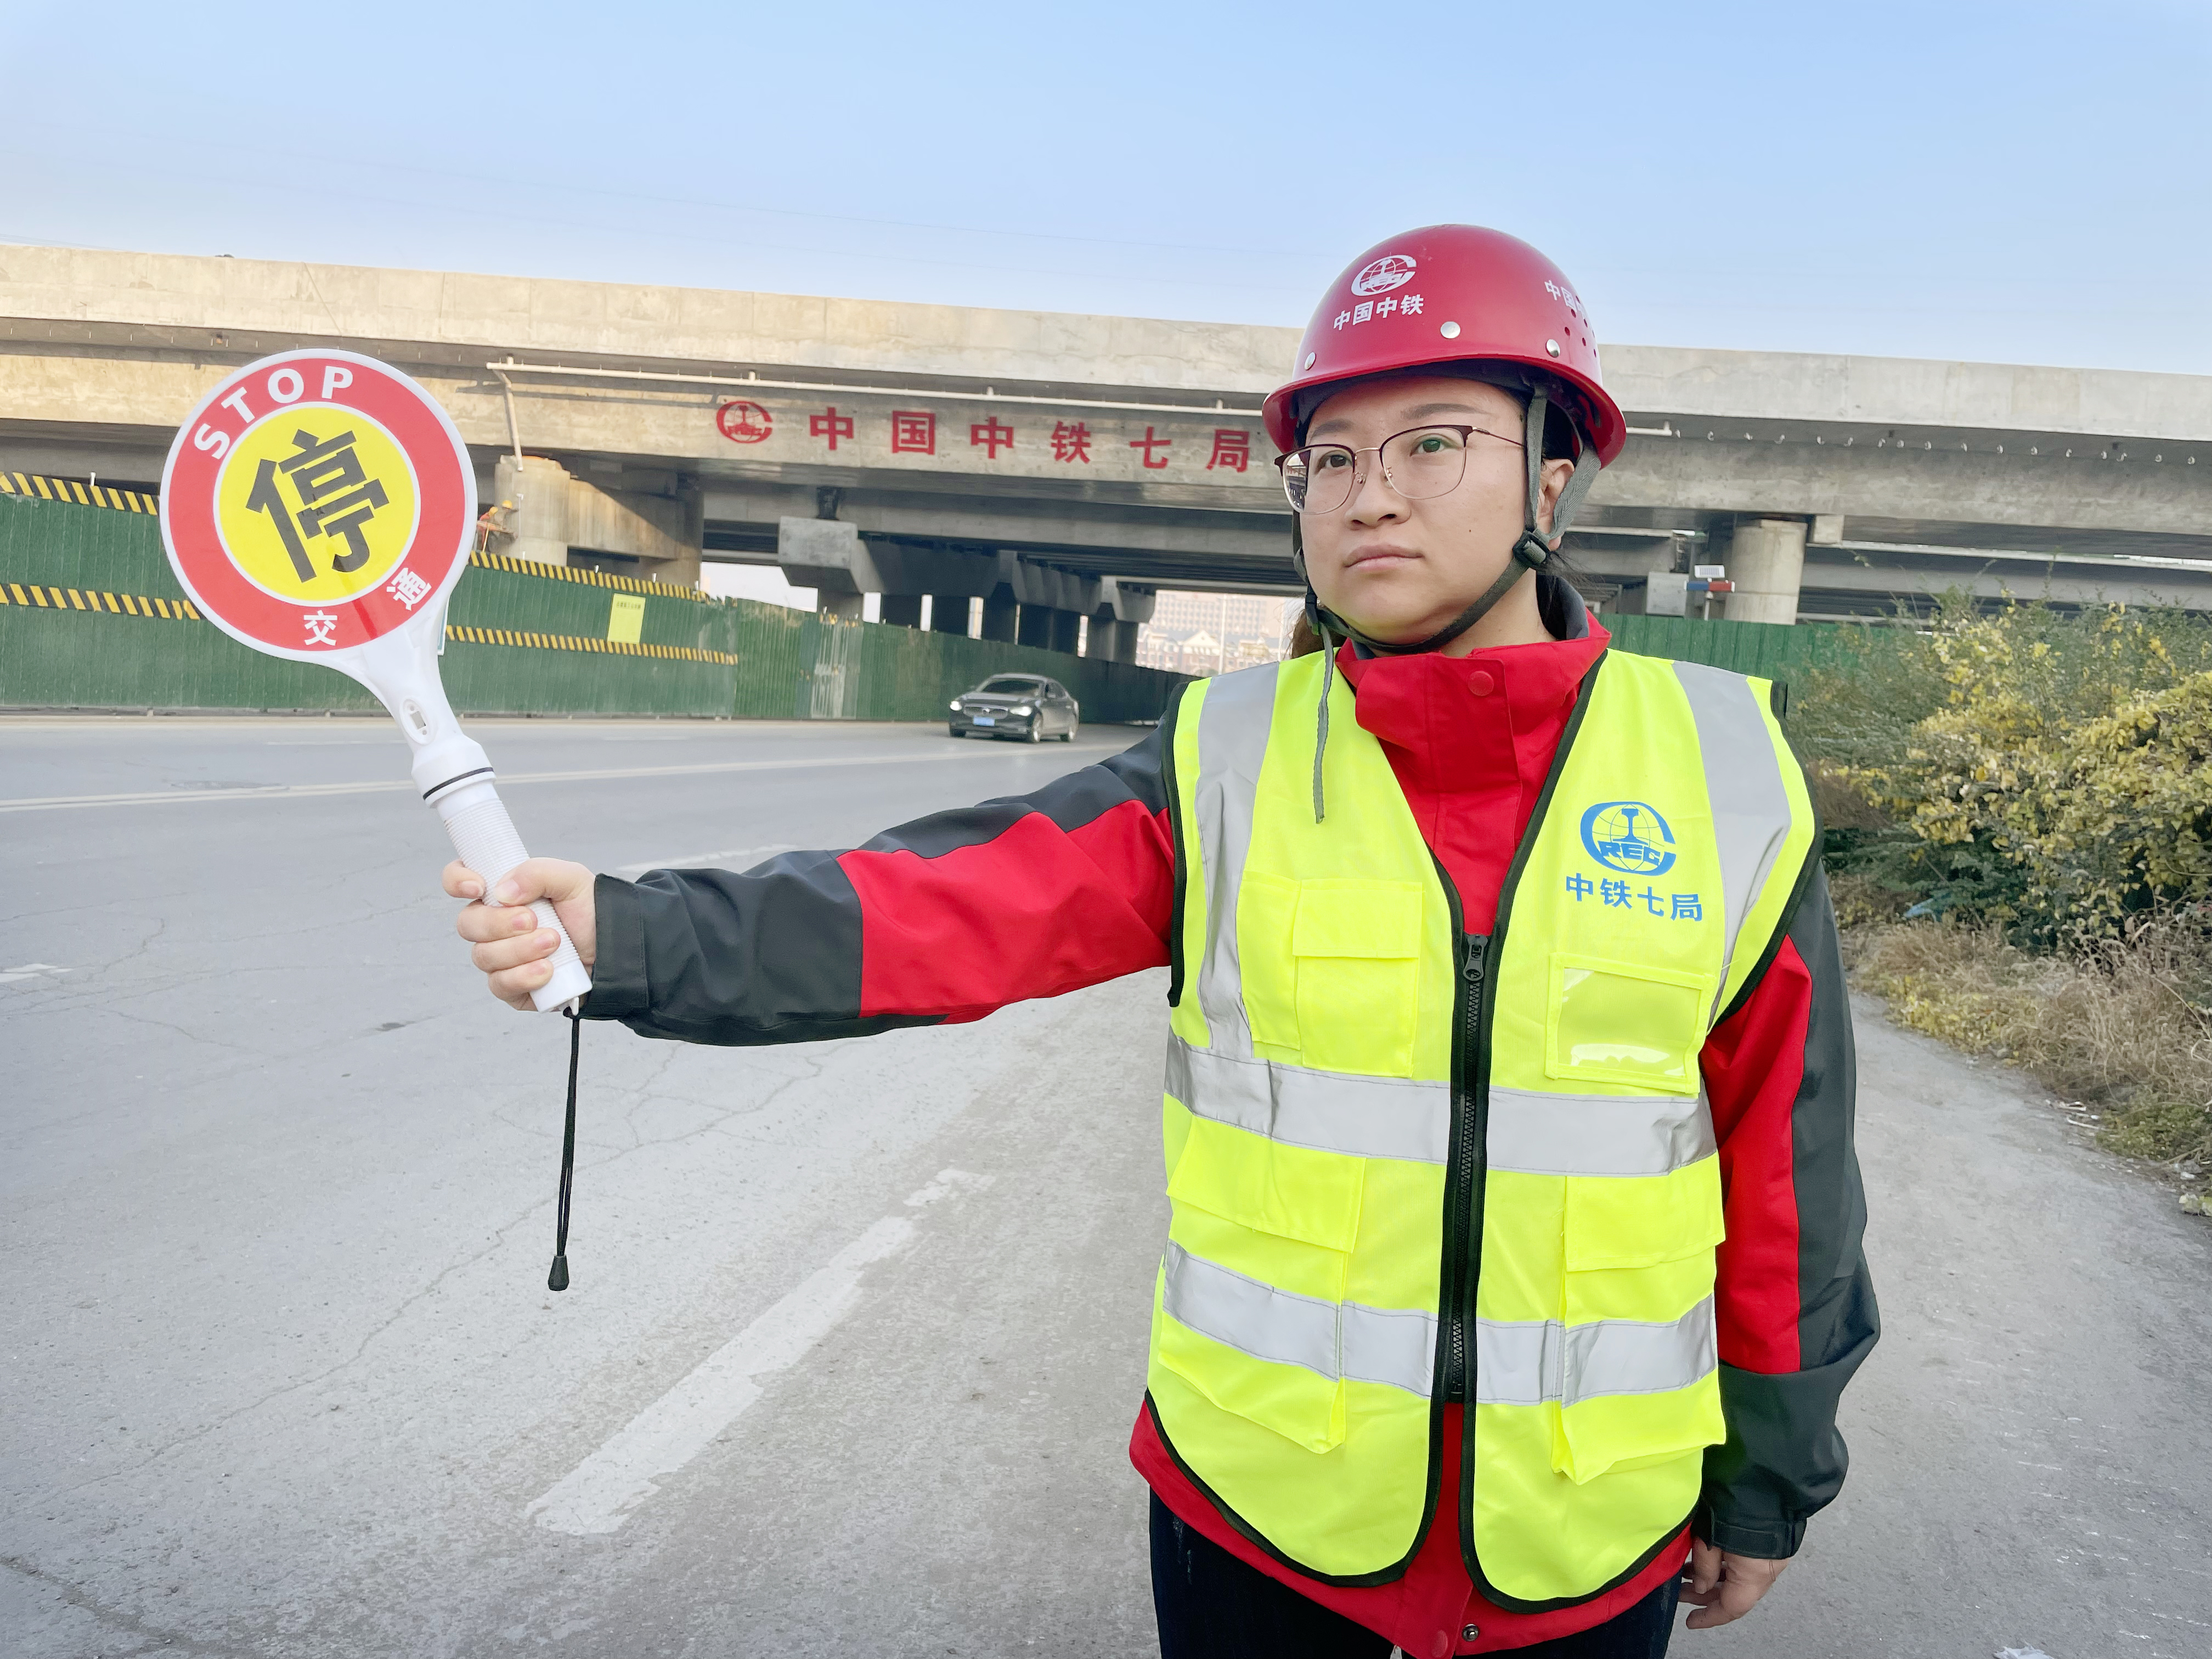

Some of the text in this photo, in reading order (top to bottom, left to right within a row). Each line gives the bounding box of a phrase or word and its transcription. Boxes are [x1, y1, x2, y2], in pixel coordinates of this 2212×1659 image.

[1333, 294, 1425, 331] 中国中铁
[194, 365, 354, 459] STOP
[809, 407, 1250, 473] 中国中铁七局
[245, 428, 390, 583] 停
[1566, 872, 1703, 922] 中铁七局
